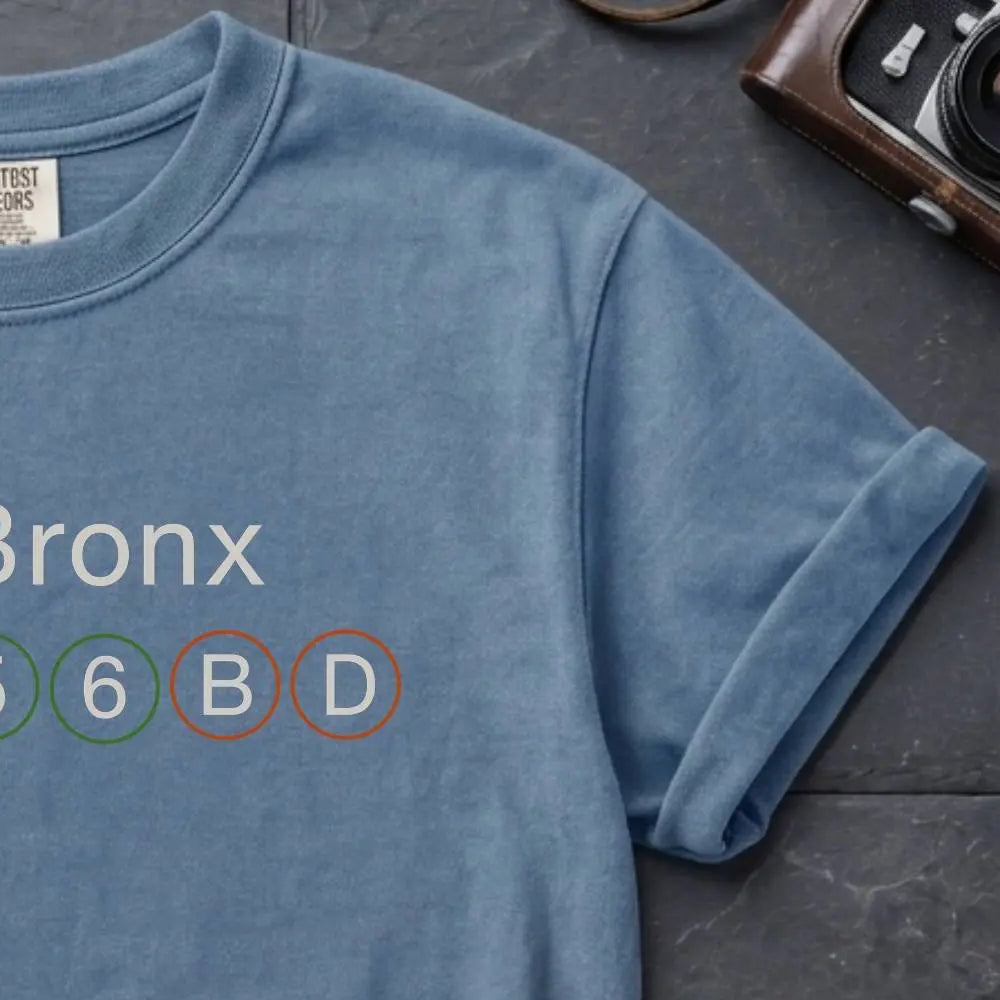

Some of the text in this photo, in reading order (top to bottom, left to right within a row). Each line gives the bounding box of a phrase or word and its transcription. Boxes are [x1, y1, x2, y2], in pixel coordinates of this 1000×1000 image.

[82, 654, 128, 720] 6
[202, 652, 254, 717] B
[325, 652, 377, 717] D
